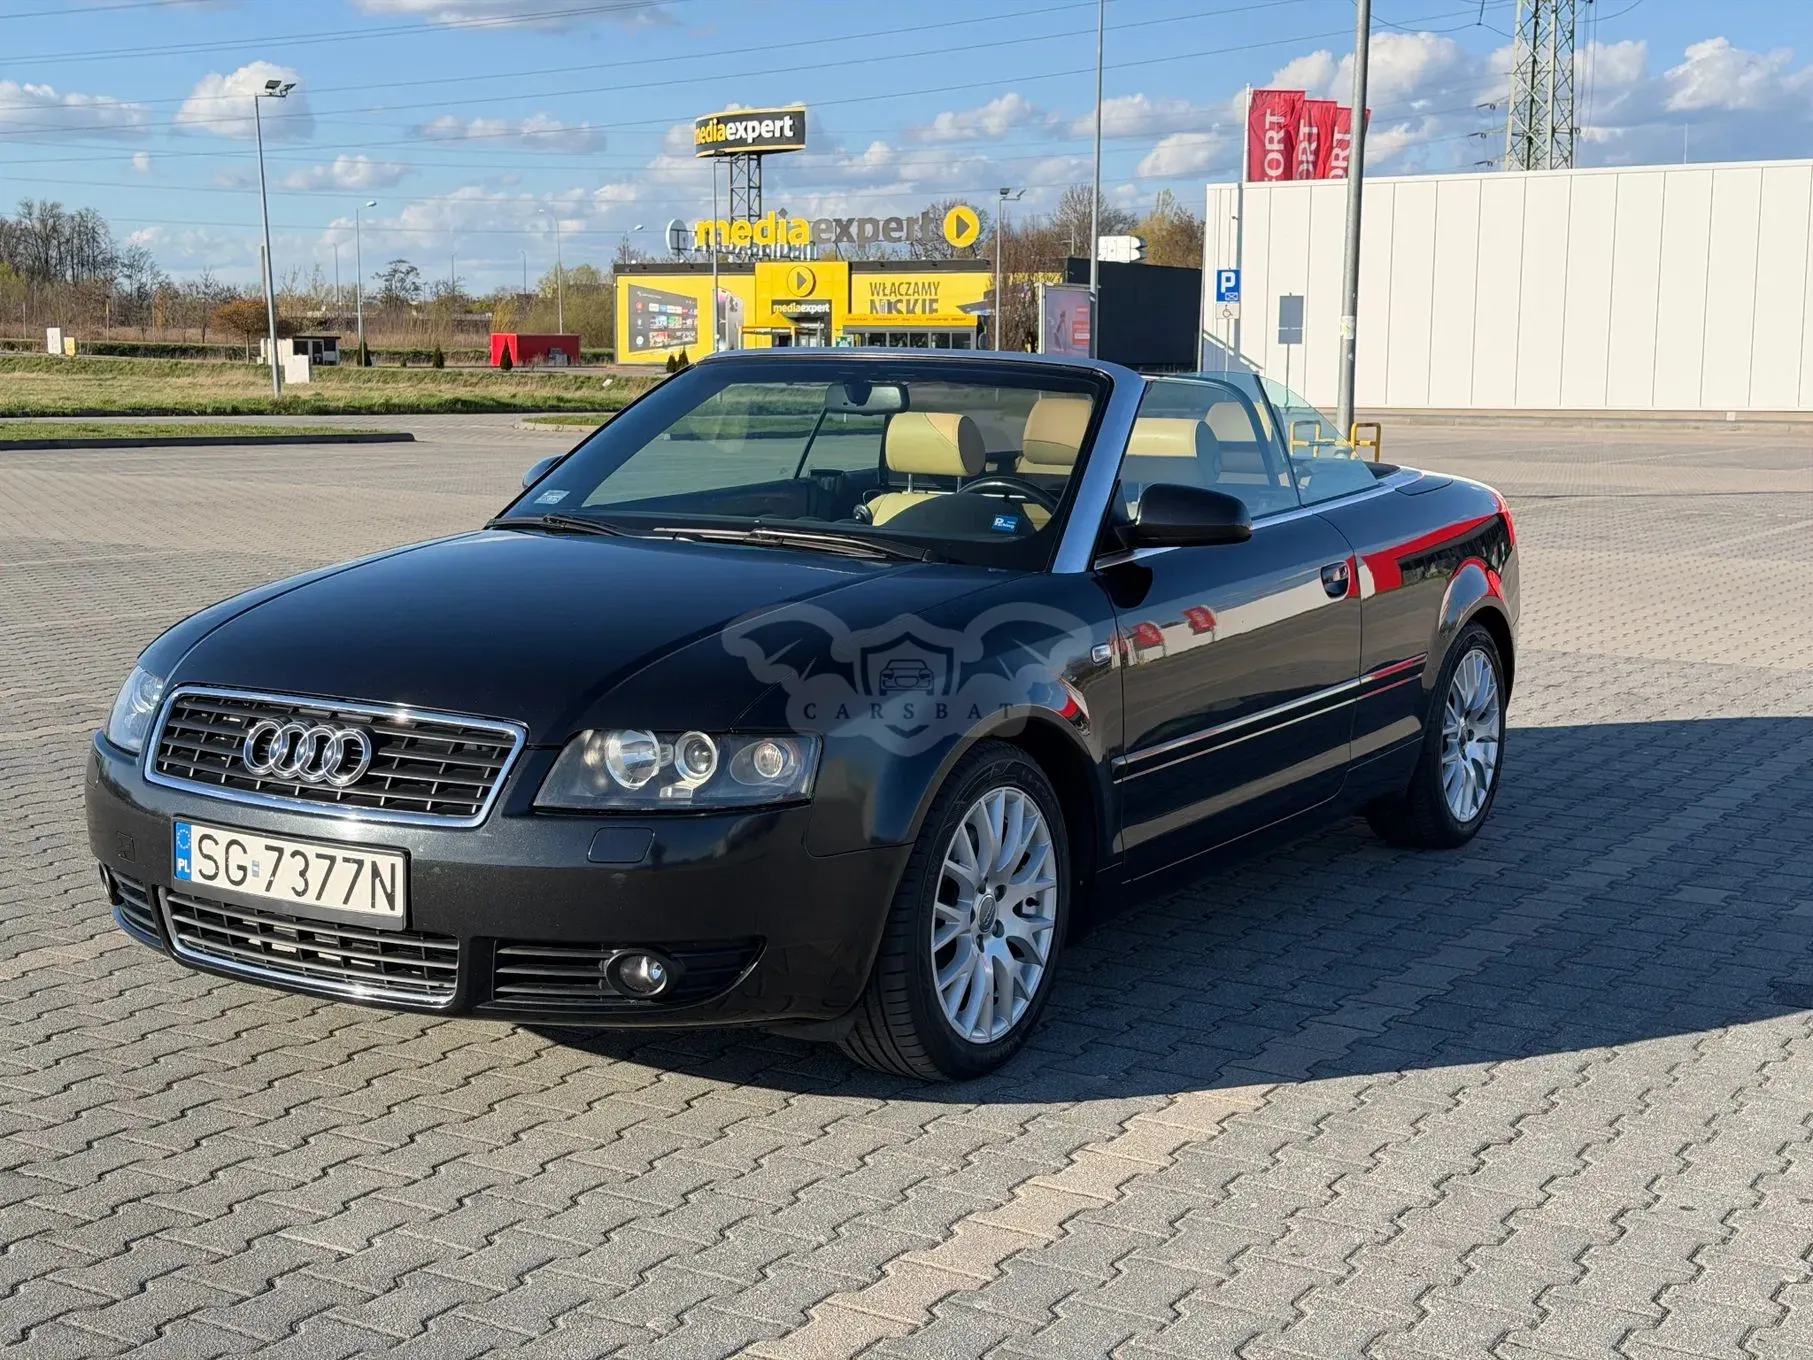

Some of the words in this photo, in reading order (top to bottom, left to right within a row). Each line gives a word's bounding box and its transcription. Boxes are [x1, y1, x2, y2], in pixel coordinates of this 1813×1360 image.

[1265, 109, 1285, 181] ORT
[695, 208, 933, 249] mediaexpert
[869, 281, 940, 298] WŁĄCZAMY
[1220, 271, 1236, 293] P
[773, 302, 830, 314] mediaexpert
[178, 857, 191, 873] PL
[198, 833, 248, 887] SG
[264, 844, 396, 911] 7377N
